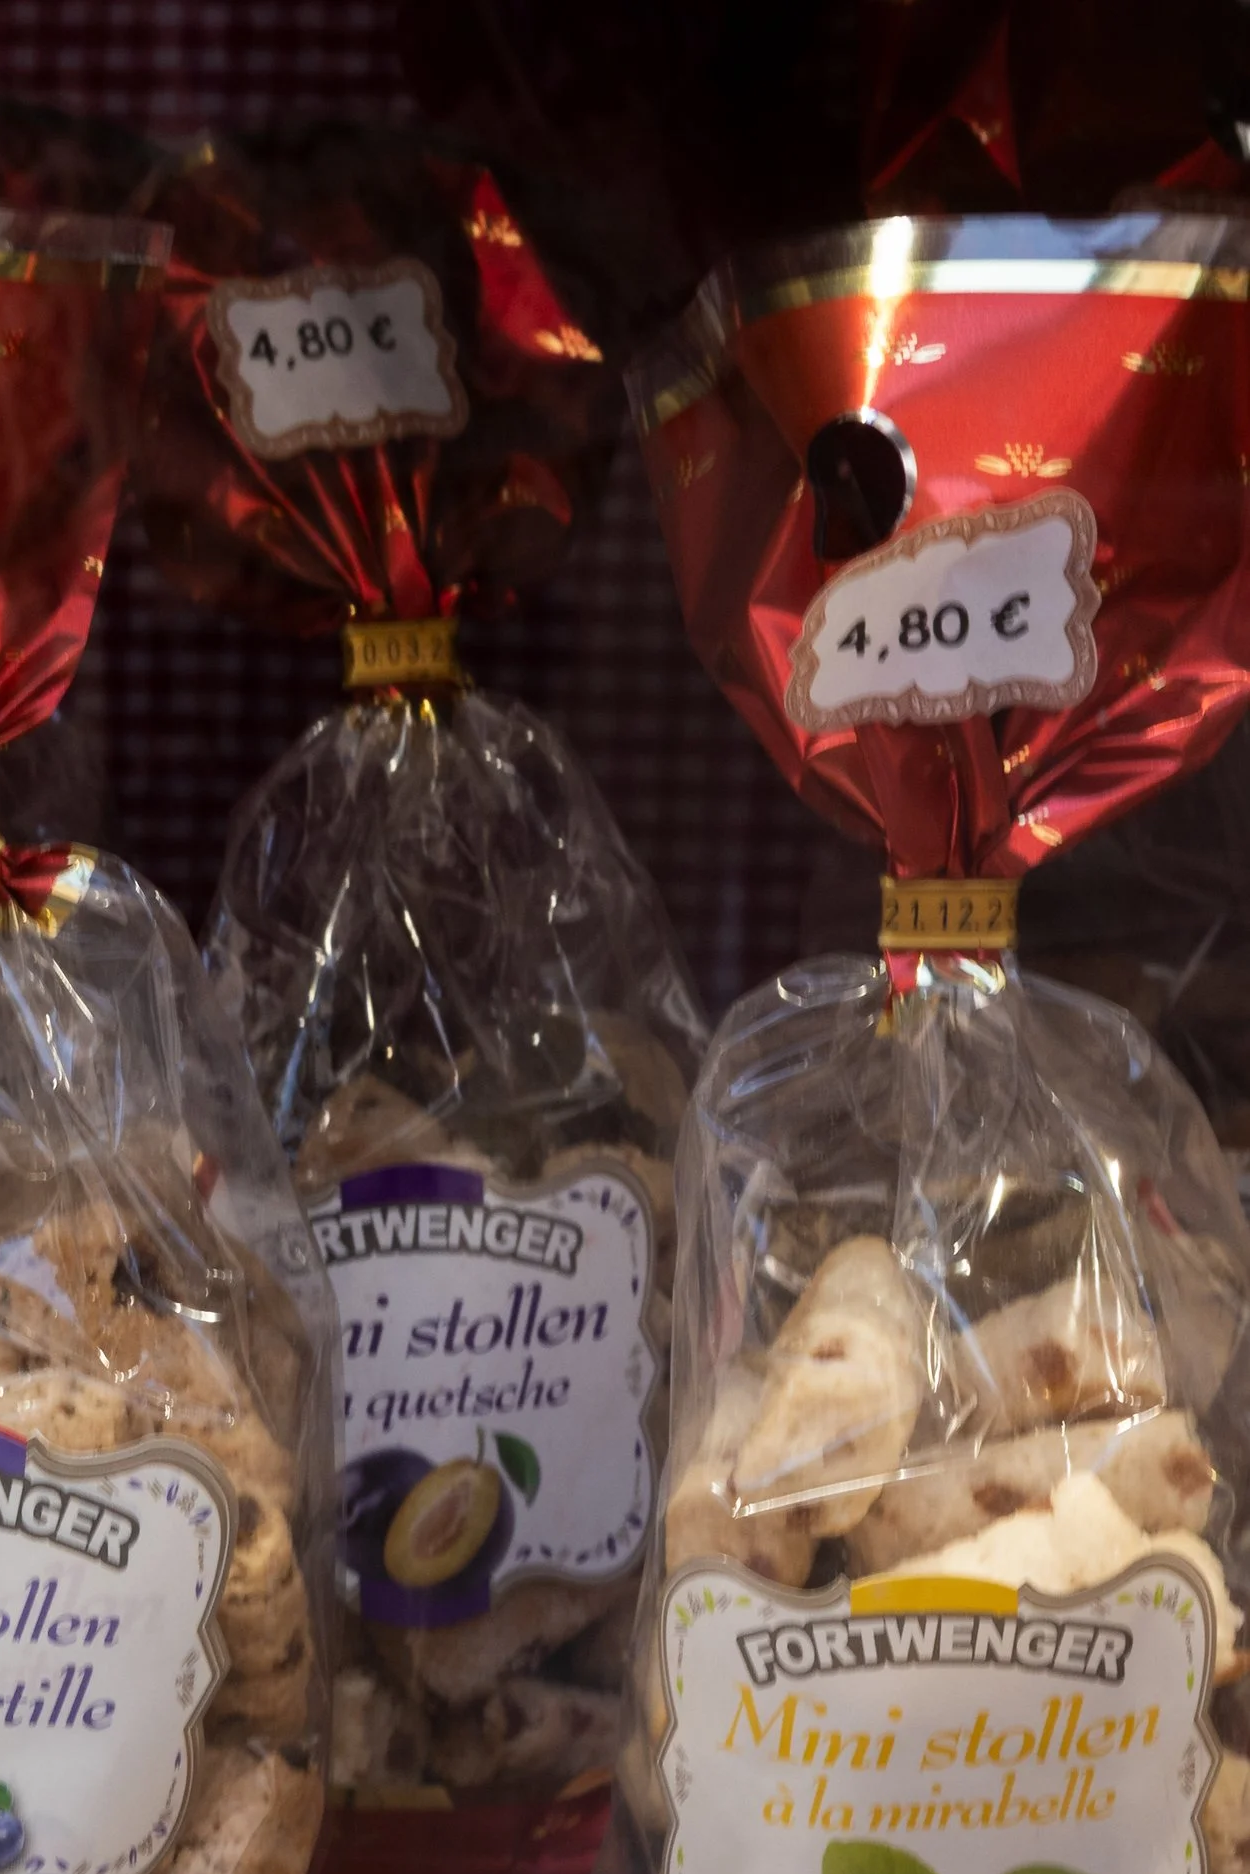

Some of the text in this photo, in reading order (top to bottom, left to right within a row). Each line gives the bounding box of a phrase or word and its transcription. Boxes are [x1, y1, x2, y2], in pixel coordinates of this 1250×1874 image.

[249, 314, 398, 370] 4,80 €
[837, 592, 1032, 661] 4,80 €
[311, 1202, 584, 1277] RTWENGER
[406, 1280, 610, 1360] stollen
[365, 1358, 573, 1432] quetsche
[737, 1613, 1133, 1687] FORTWENGER
[719, 1680, 1163, 1773] Mini stollen
[761, 1767, 1118, 1833] à la mirabelle
